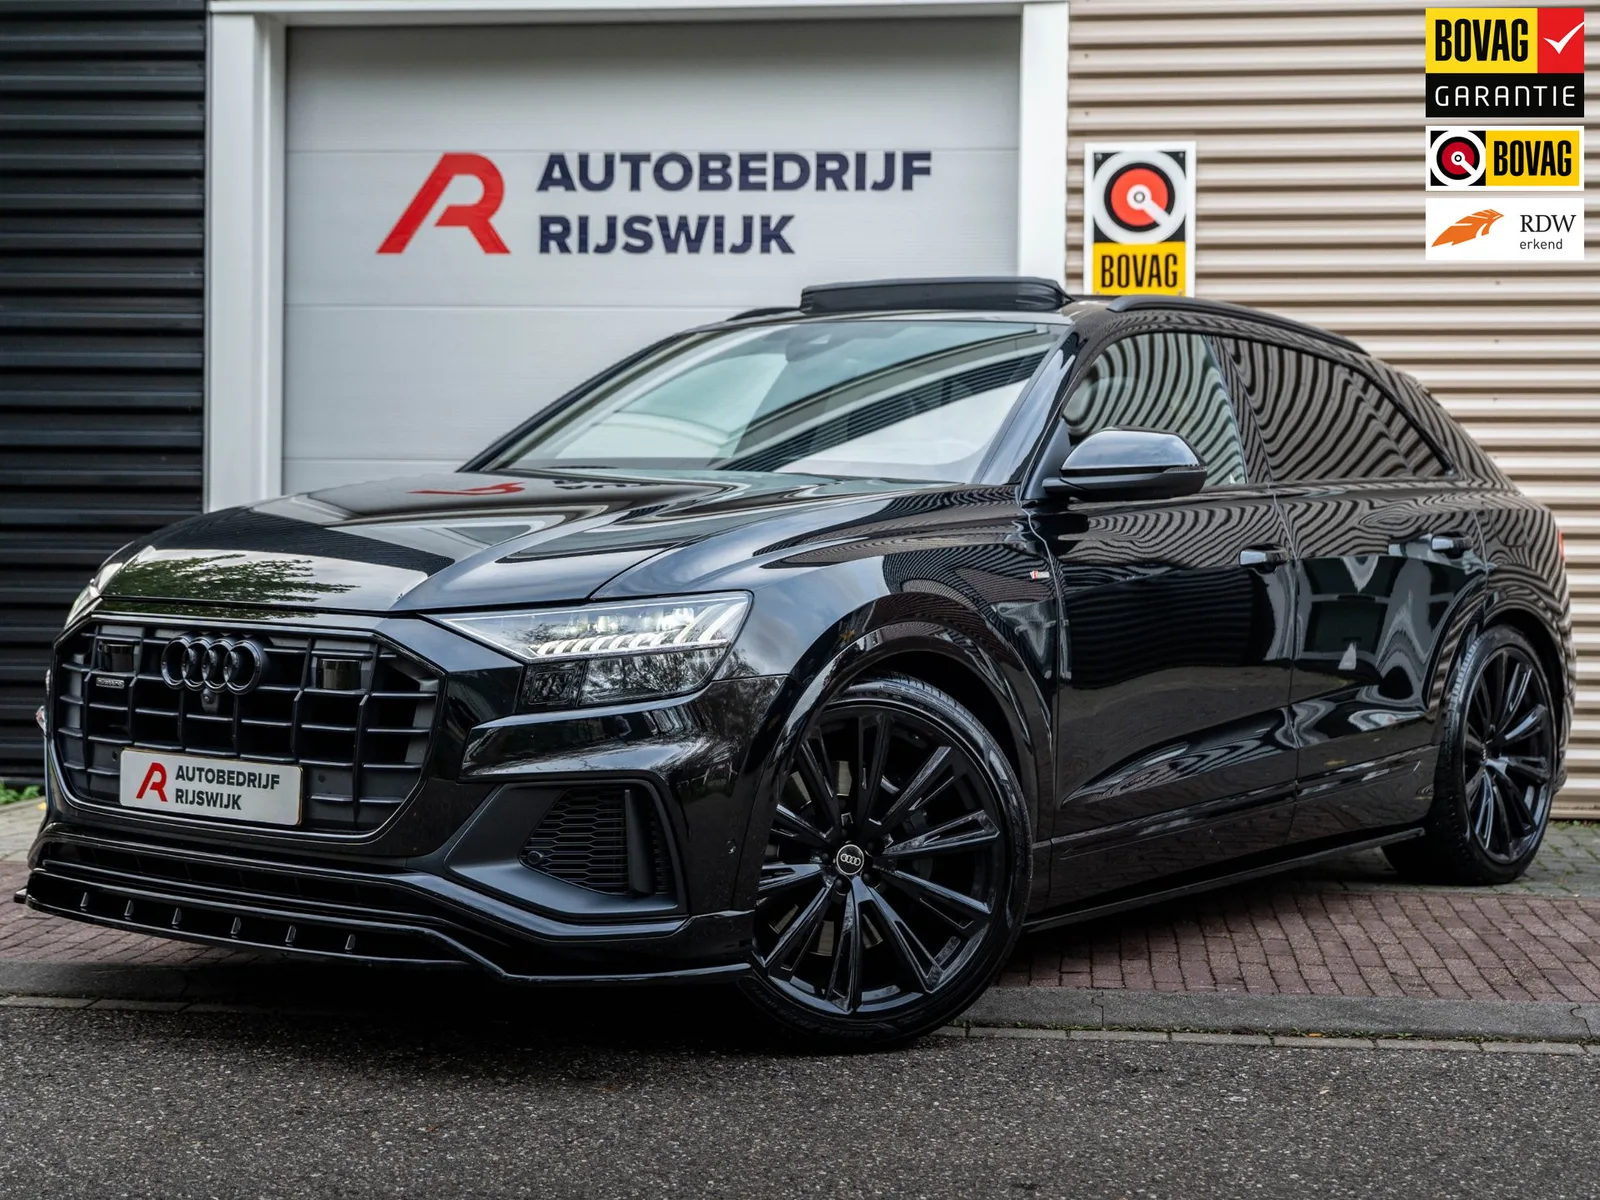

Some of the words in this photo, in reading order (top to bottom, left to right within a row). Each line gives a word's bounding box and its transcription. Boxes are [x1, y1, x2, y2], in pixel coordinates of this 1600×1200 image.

[537, 152, 932, 192] AUTOBEDRIJF
[539, 214, 796, 255] RIJSWIJK
[1100, 253, 1178, 289] BOVAG
[175, 765, 280, 790] AUTOBEDRIJF
[175, 788, 242, 811] RIJSWIJK
